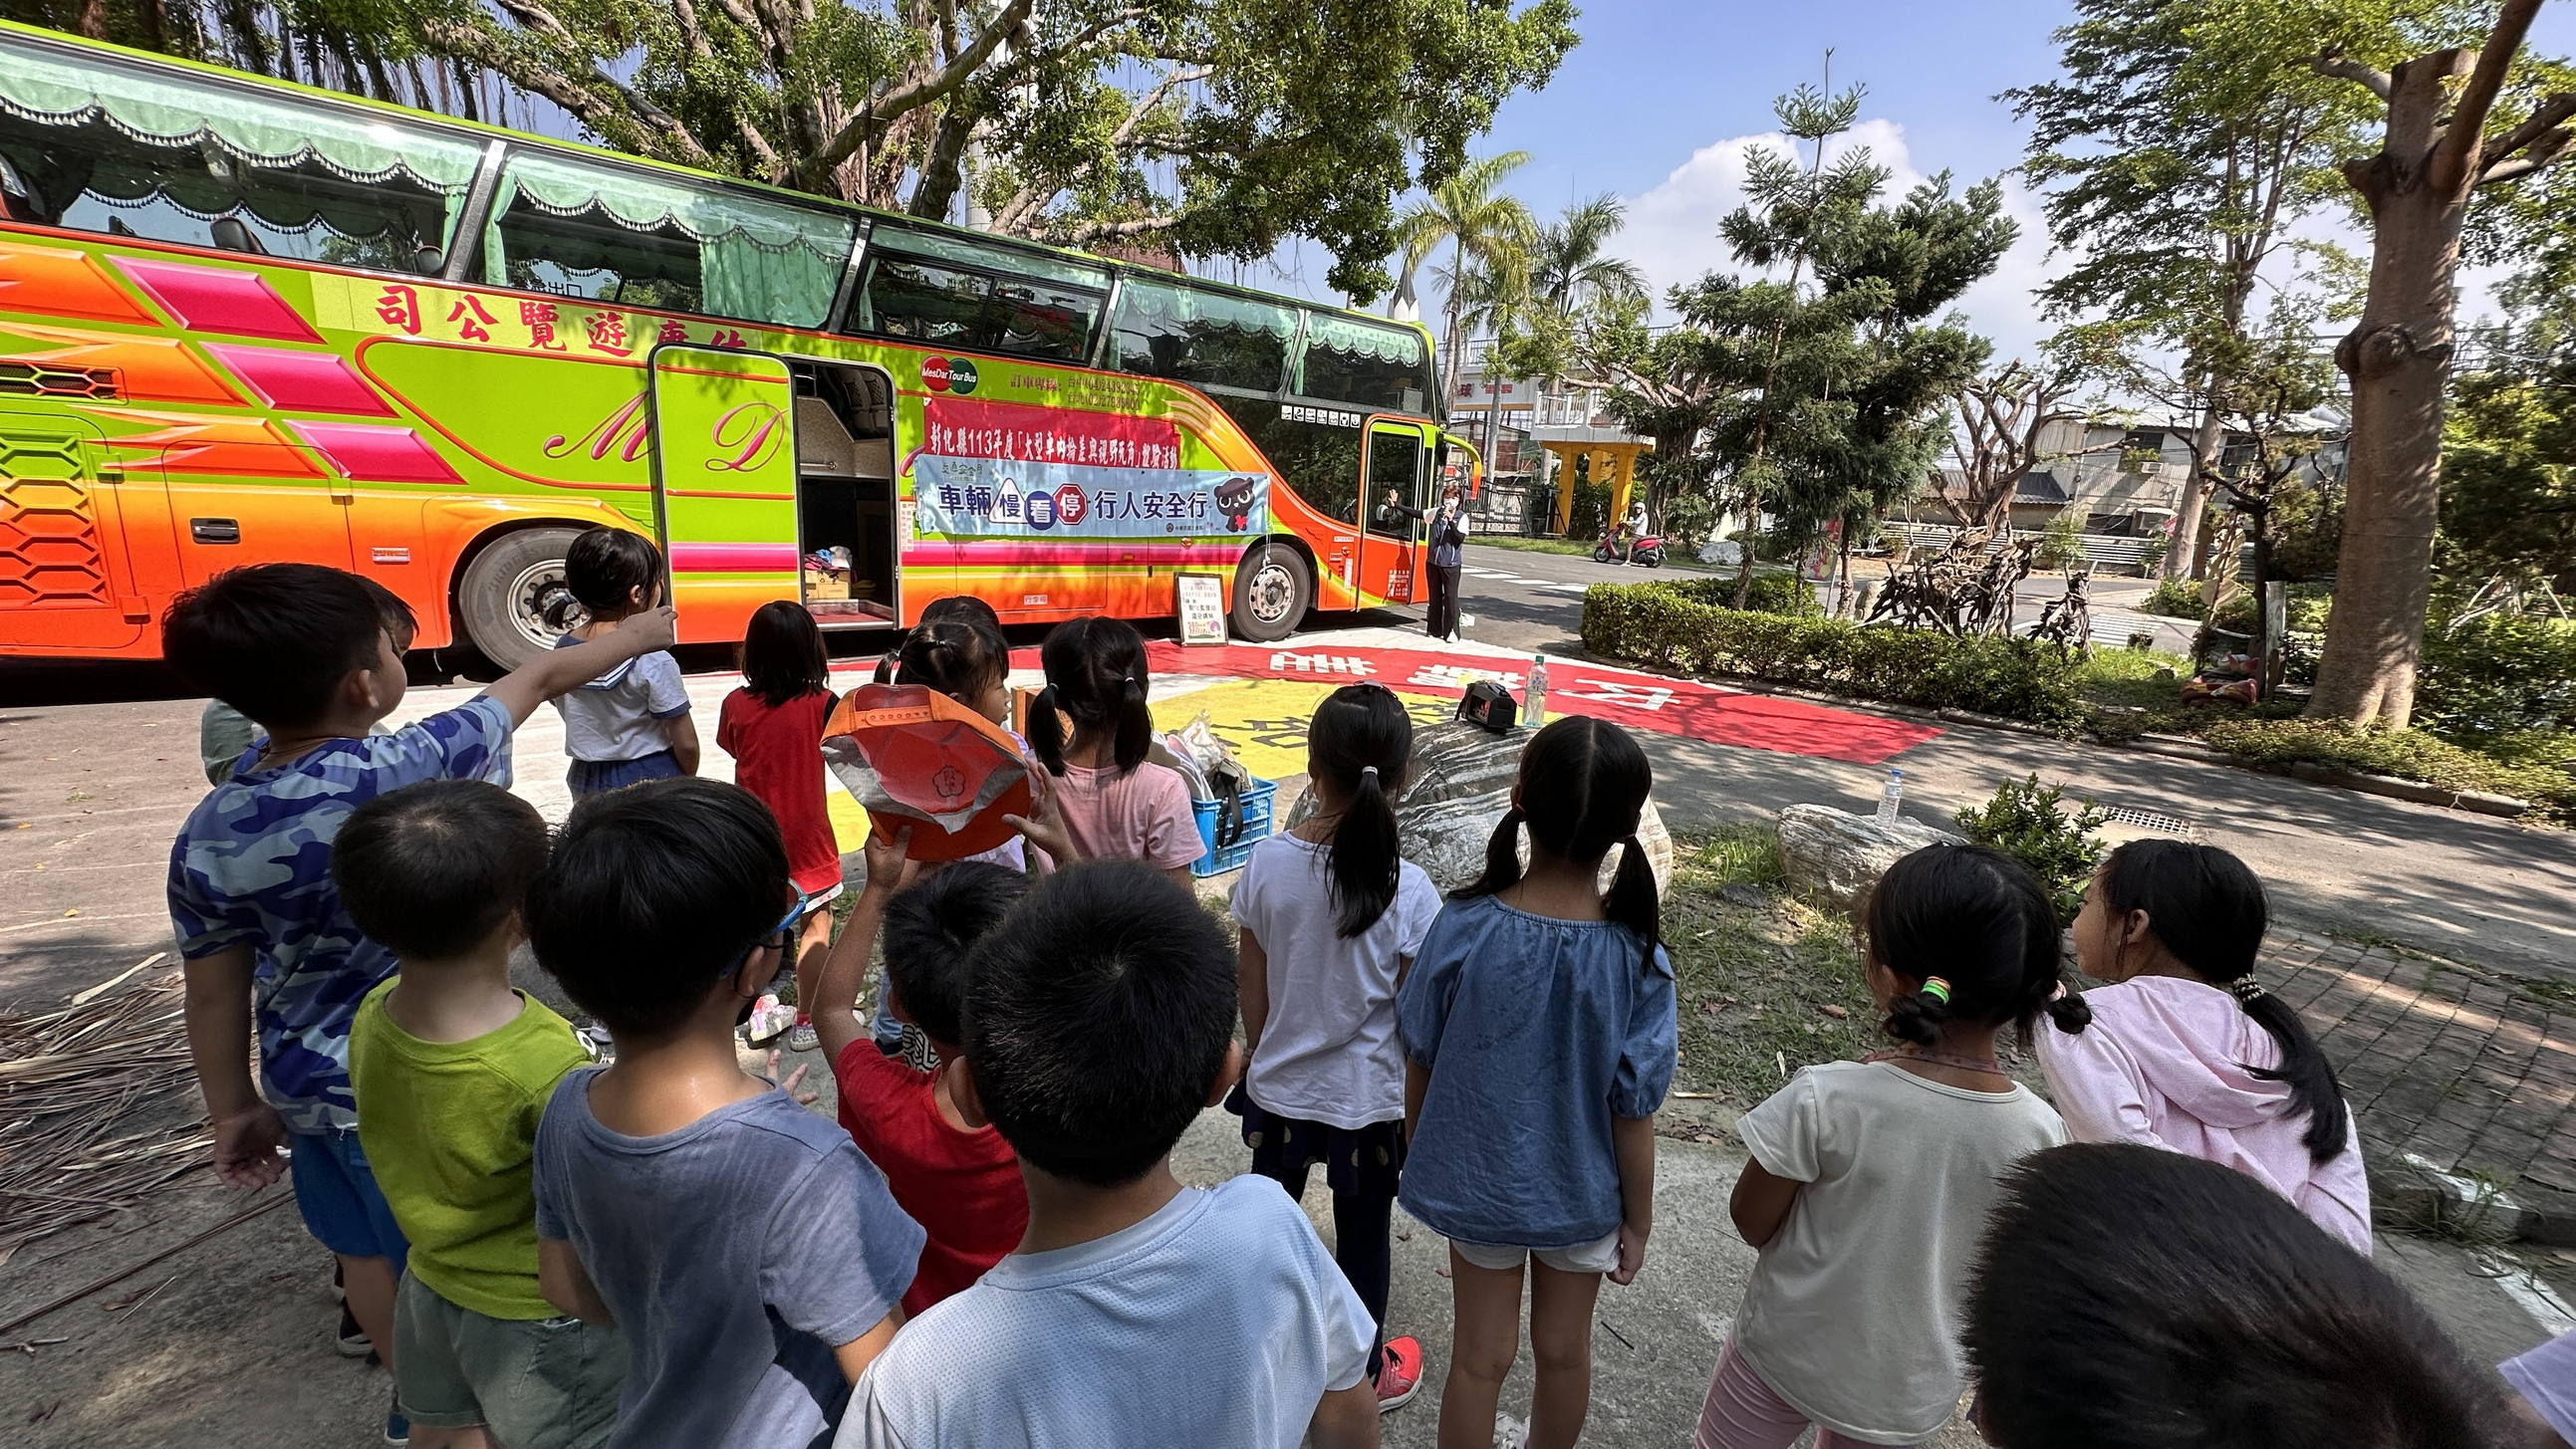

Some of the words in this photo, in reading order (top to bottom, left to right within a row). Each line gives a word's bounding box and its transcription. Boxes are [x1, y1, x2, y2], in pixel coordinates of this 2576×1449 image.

[1095, 491, 1207, 519] 行人安全行
